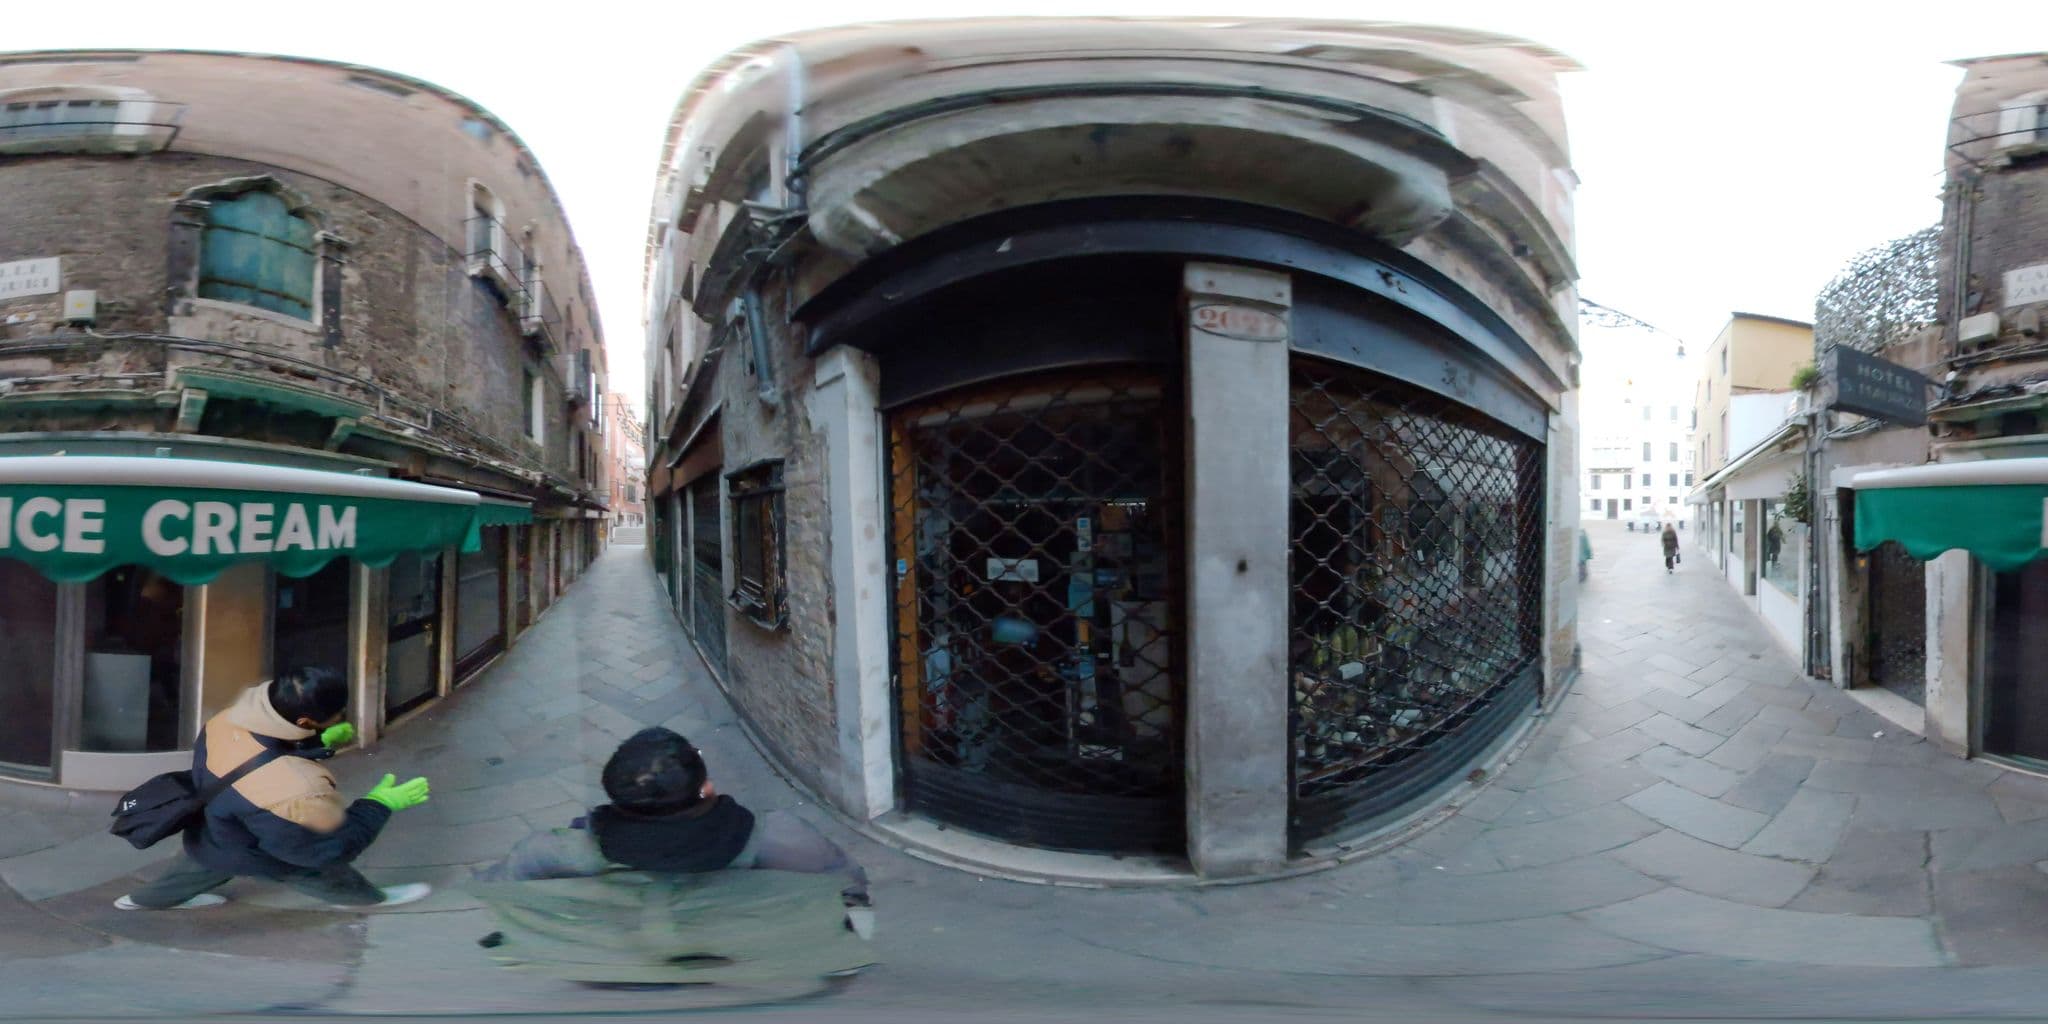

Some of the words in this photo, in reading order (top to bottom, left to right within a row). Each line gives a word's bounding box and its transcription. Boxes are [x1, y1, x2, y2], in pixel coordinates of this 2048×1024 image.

[1857, 363, 1914, 393] HOTEL
[0, 497, 106, 554] ICE
[141, 499, 358, 556] CREAM
